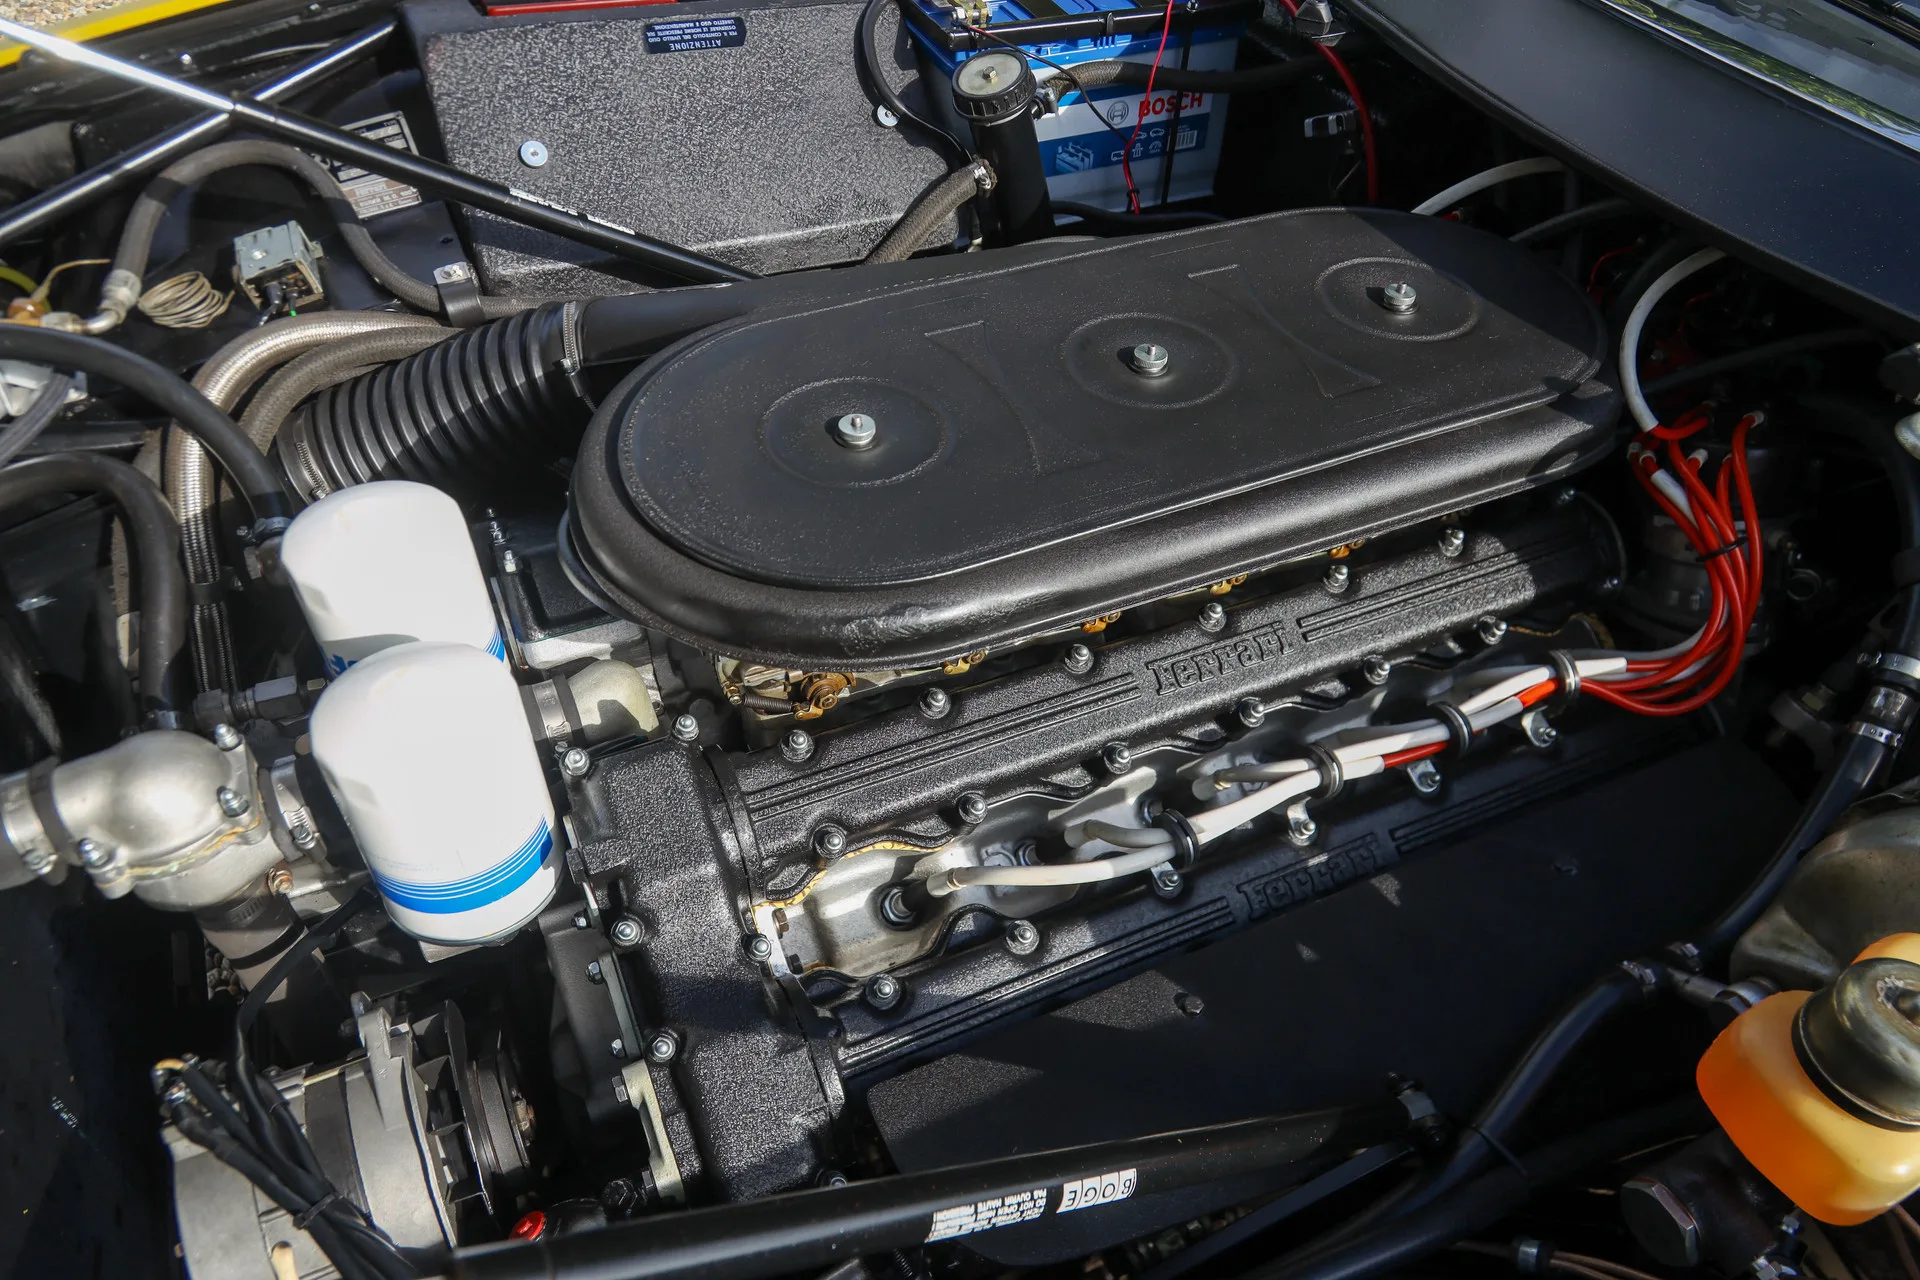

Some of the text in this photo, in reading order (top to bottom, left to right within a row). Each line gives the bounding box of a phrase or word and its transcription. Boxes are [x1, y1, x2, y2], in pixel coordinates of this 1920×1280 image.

[669, 39, 721, 50] ATTENZIONE
[1138, 92, 1204, 118] BOSCH
[1145, 621, 1294, 696] Ferrari
[1236, 832, 1388, 921] Ferrari
[1067, 1178, 1133, 1207] BOGE
[997, 1204, 1017, 1215] OPEN
[1019, 1200, 1034, 1211] NOT
[1036, 1198, 1046, 1207] DO
